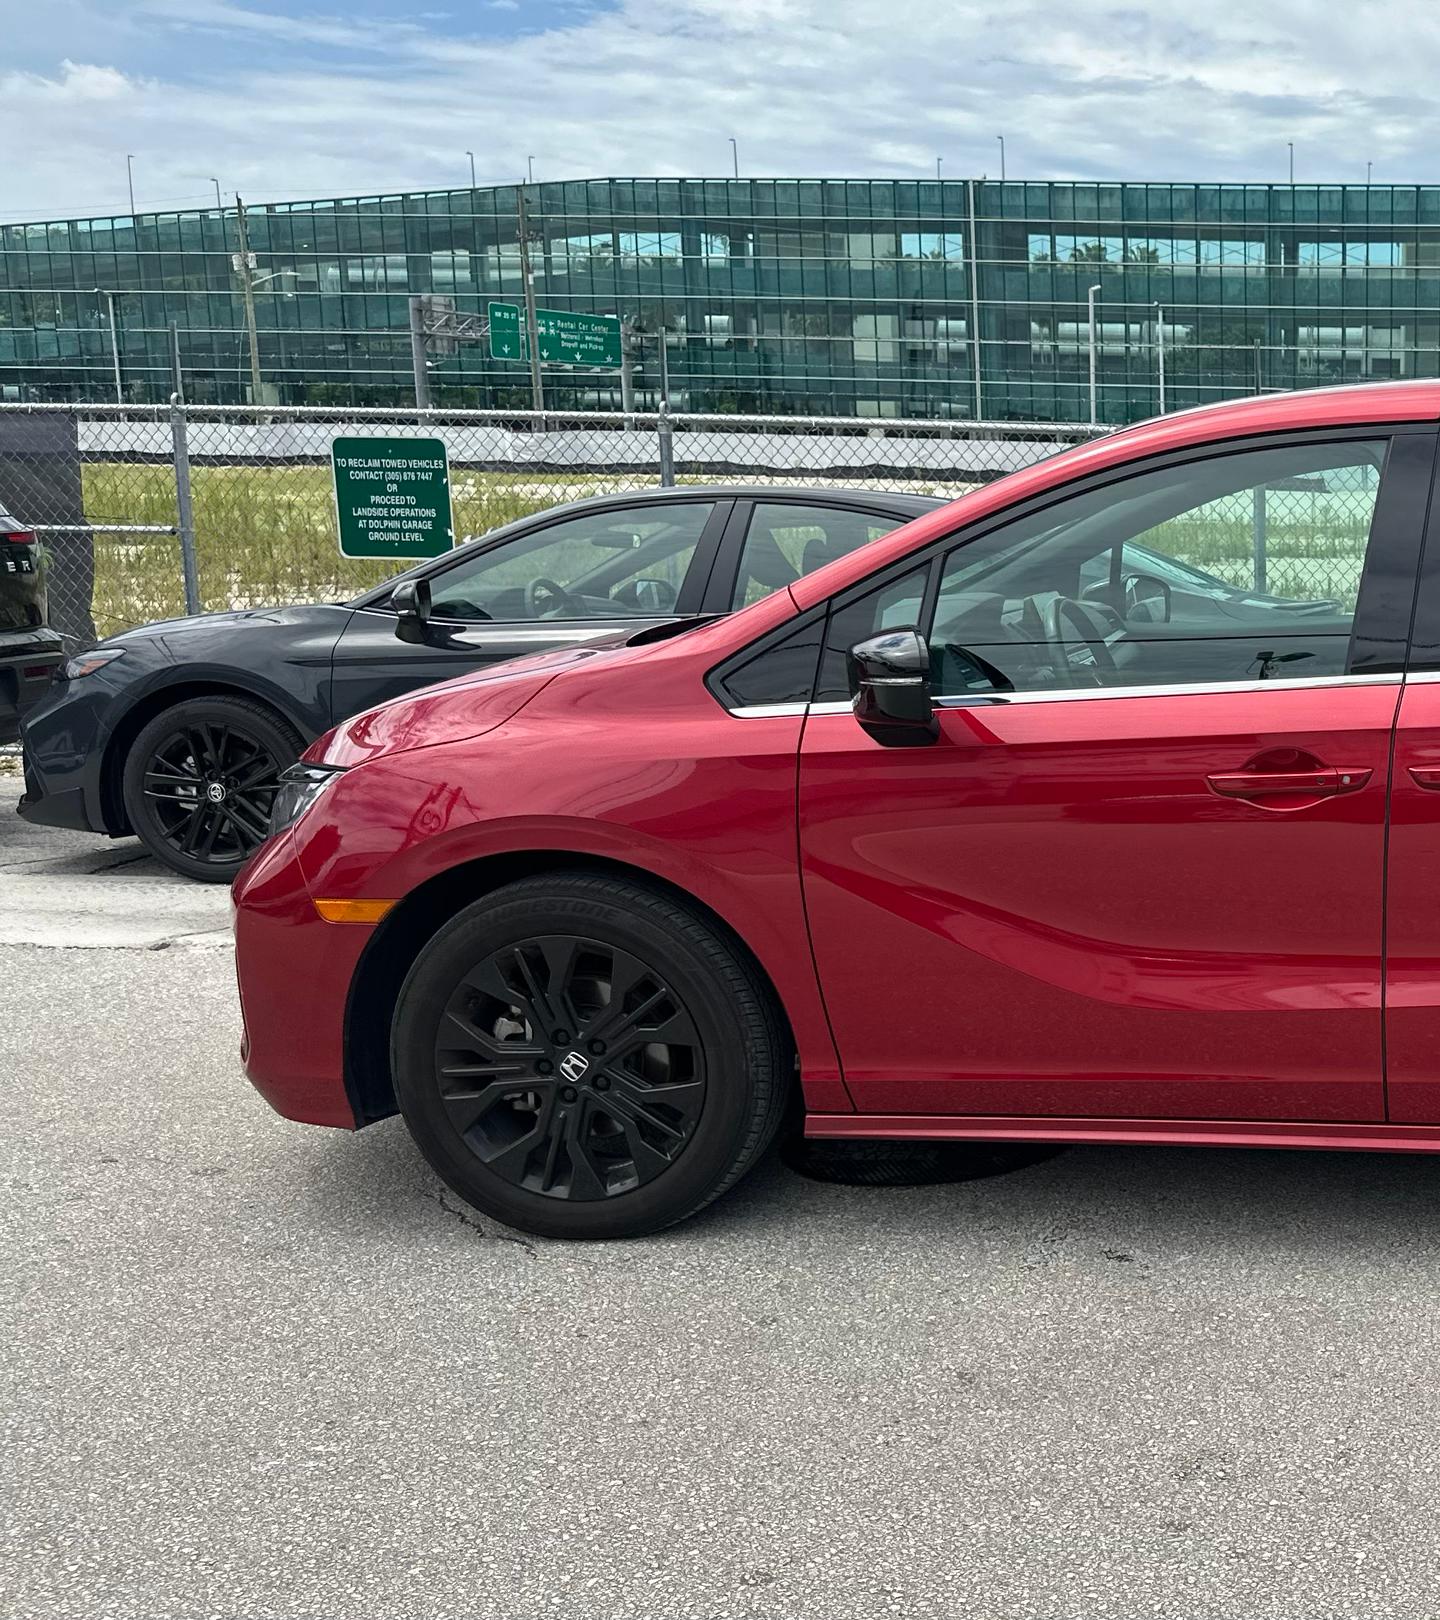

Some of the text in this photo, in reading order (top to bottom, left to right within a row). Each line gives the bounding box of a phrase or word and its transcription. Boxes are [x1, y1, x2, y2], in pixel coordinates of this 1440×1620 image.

[557, 320, 609, 333] Rental Car Center
[336, 458, 444, 469] TO RECLAIM TOWED VEHICLES
[349, 470, 433, 482] CONTACT (305) 876 7447
[386, 483, 398, 493] OR
[370, 495, 417, 506] PROCEED TO
[352, 507, 437, 518] LANDSIDE OPERATIONS
[358, 519, 433, 530] AT DOLPHIN GARAGE
[368, 531, 425, 542] GROUND LEVEL
